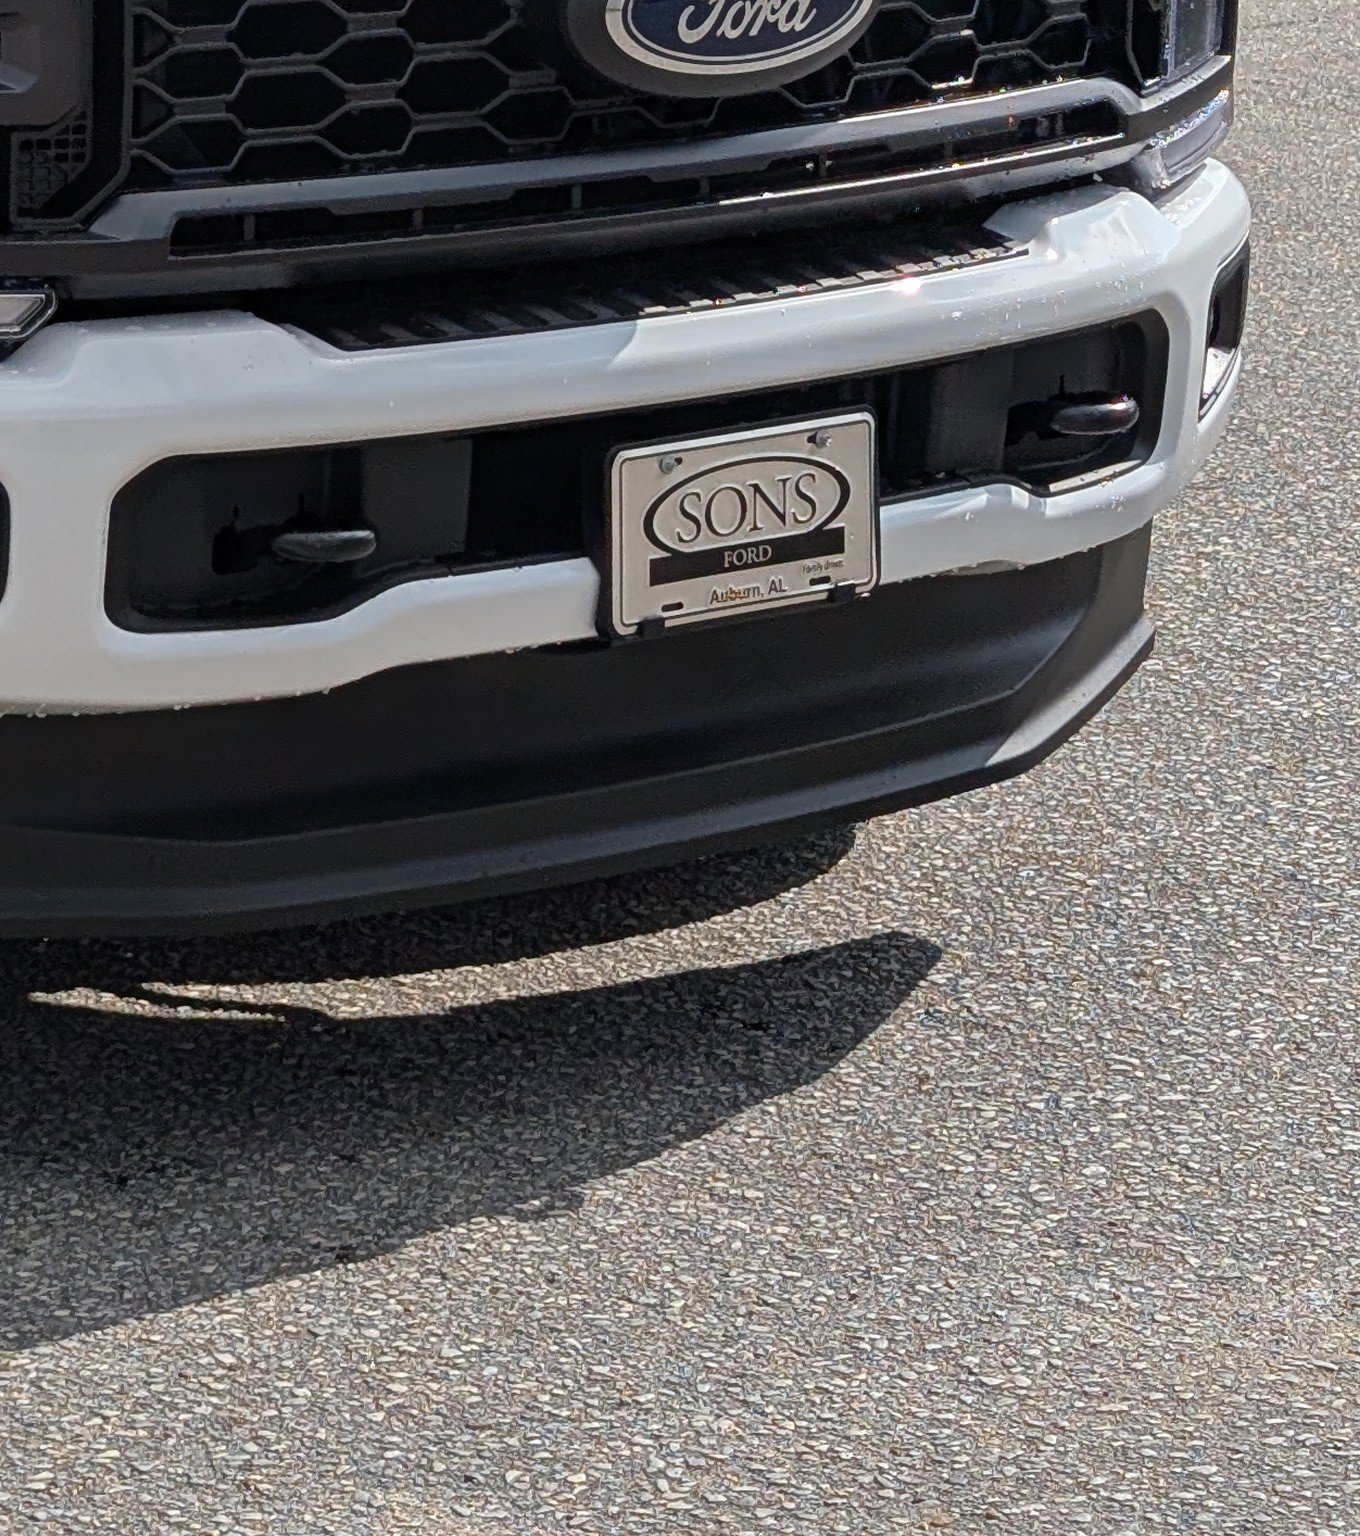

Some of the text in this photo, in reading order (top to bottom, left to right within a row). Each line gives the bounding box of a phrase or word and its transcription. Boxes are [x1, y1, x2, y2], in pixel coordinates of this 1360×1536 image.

[675, 472, 818, 544] SONS
[723, 544, 773, 568] FORD
[767, 577, 789, 596] AL
